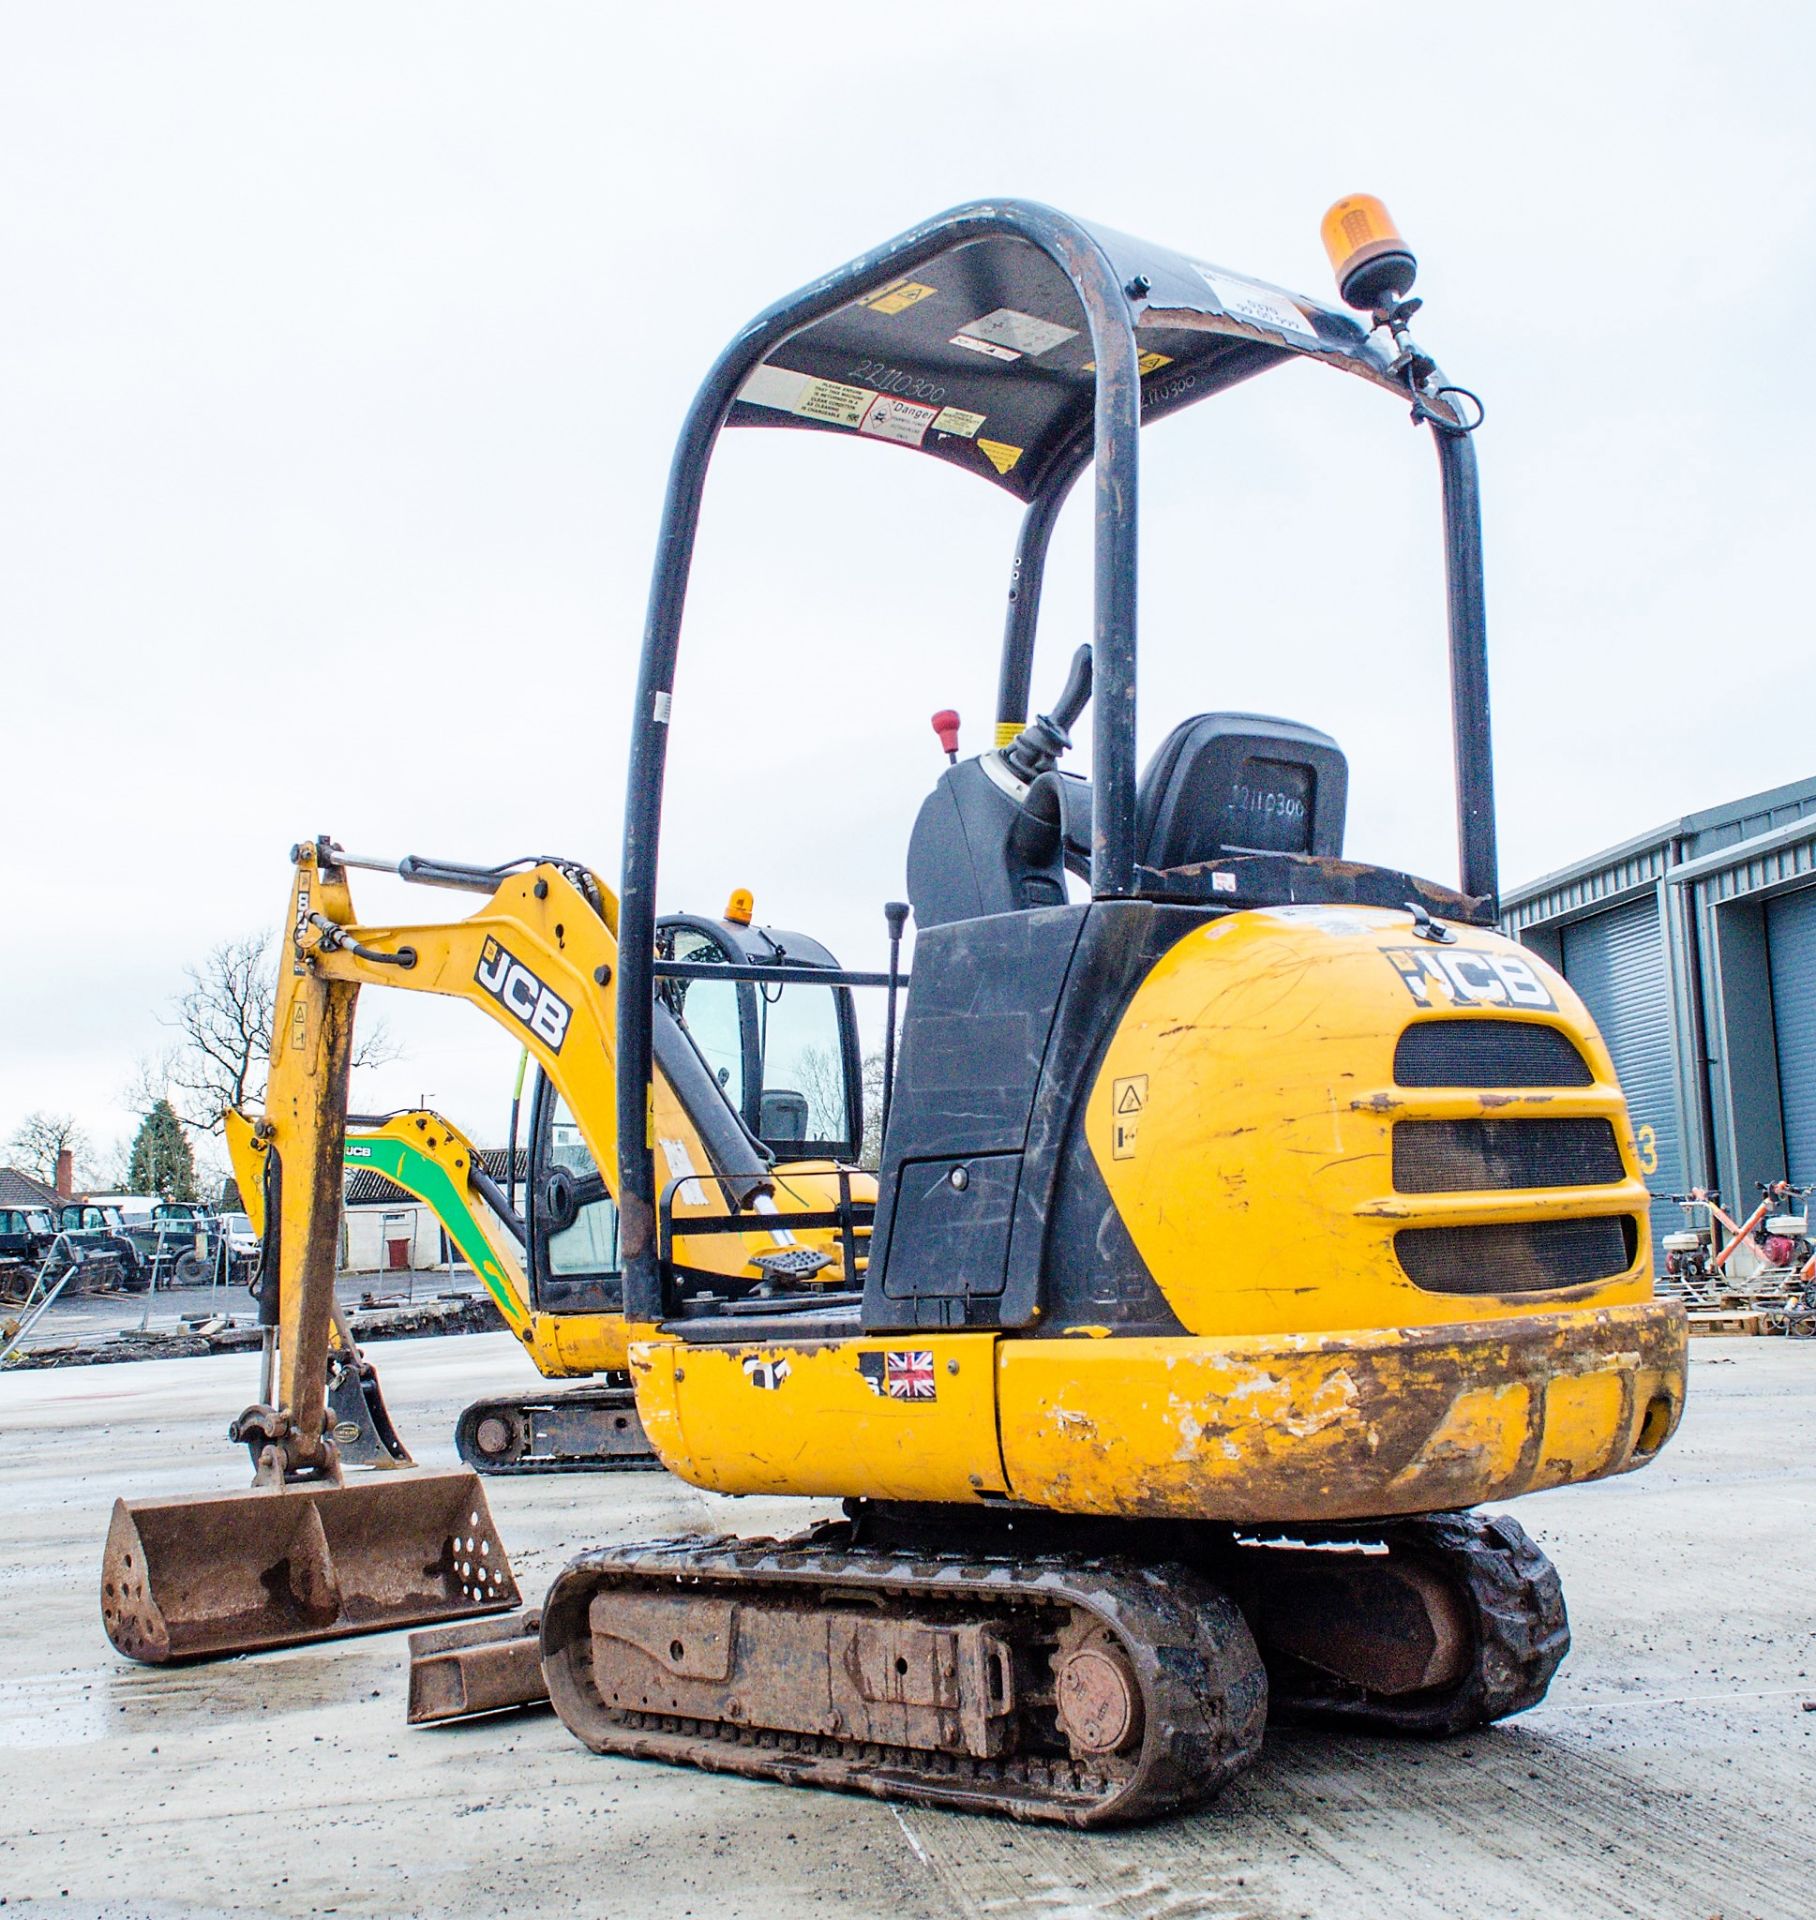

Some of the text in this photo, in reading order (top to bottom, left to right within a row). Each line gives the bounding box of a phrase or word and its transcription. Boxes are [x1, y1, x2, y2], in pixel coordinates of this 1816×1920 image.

[848, 360, 945, 402] 22110300
[894, 402, 934, 420] Danger
[478, 951, 569, 1048] JCB
[1405, 950, 1551, 1006] JCB
[346, 1146, 371, 1157] JCB
[1637, 1124, 1659, 1175] 3
